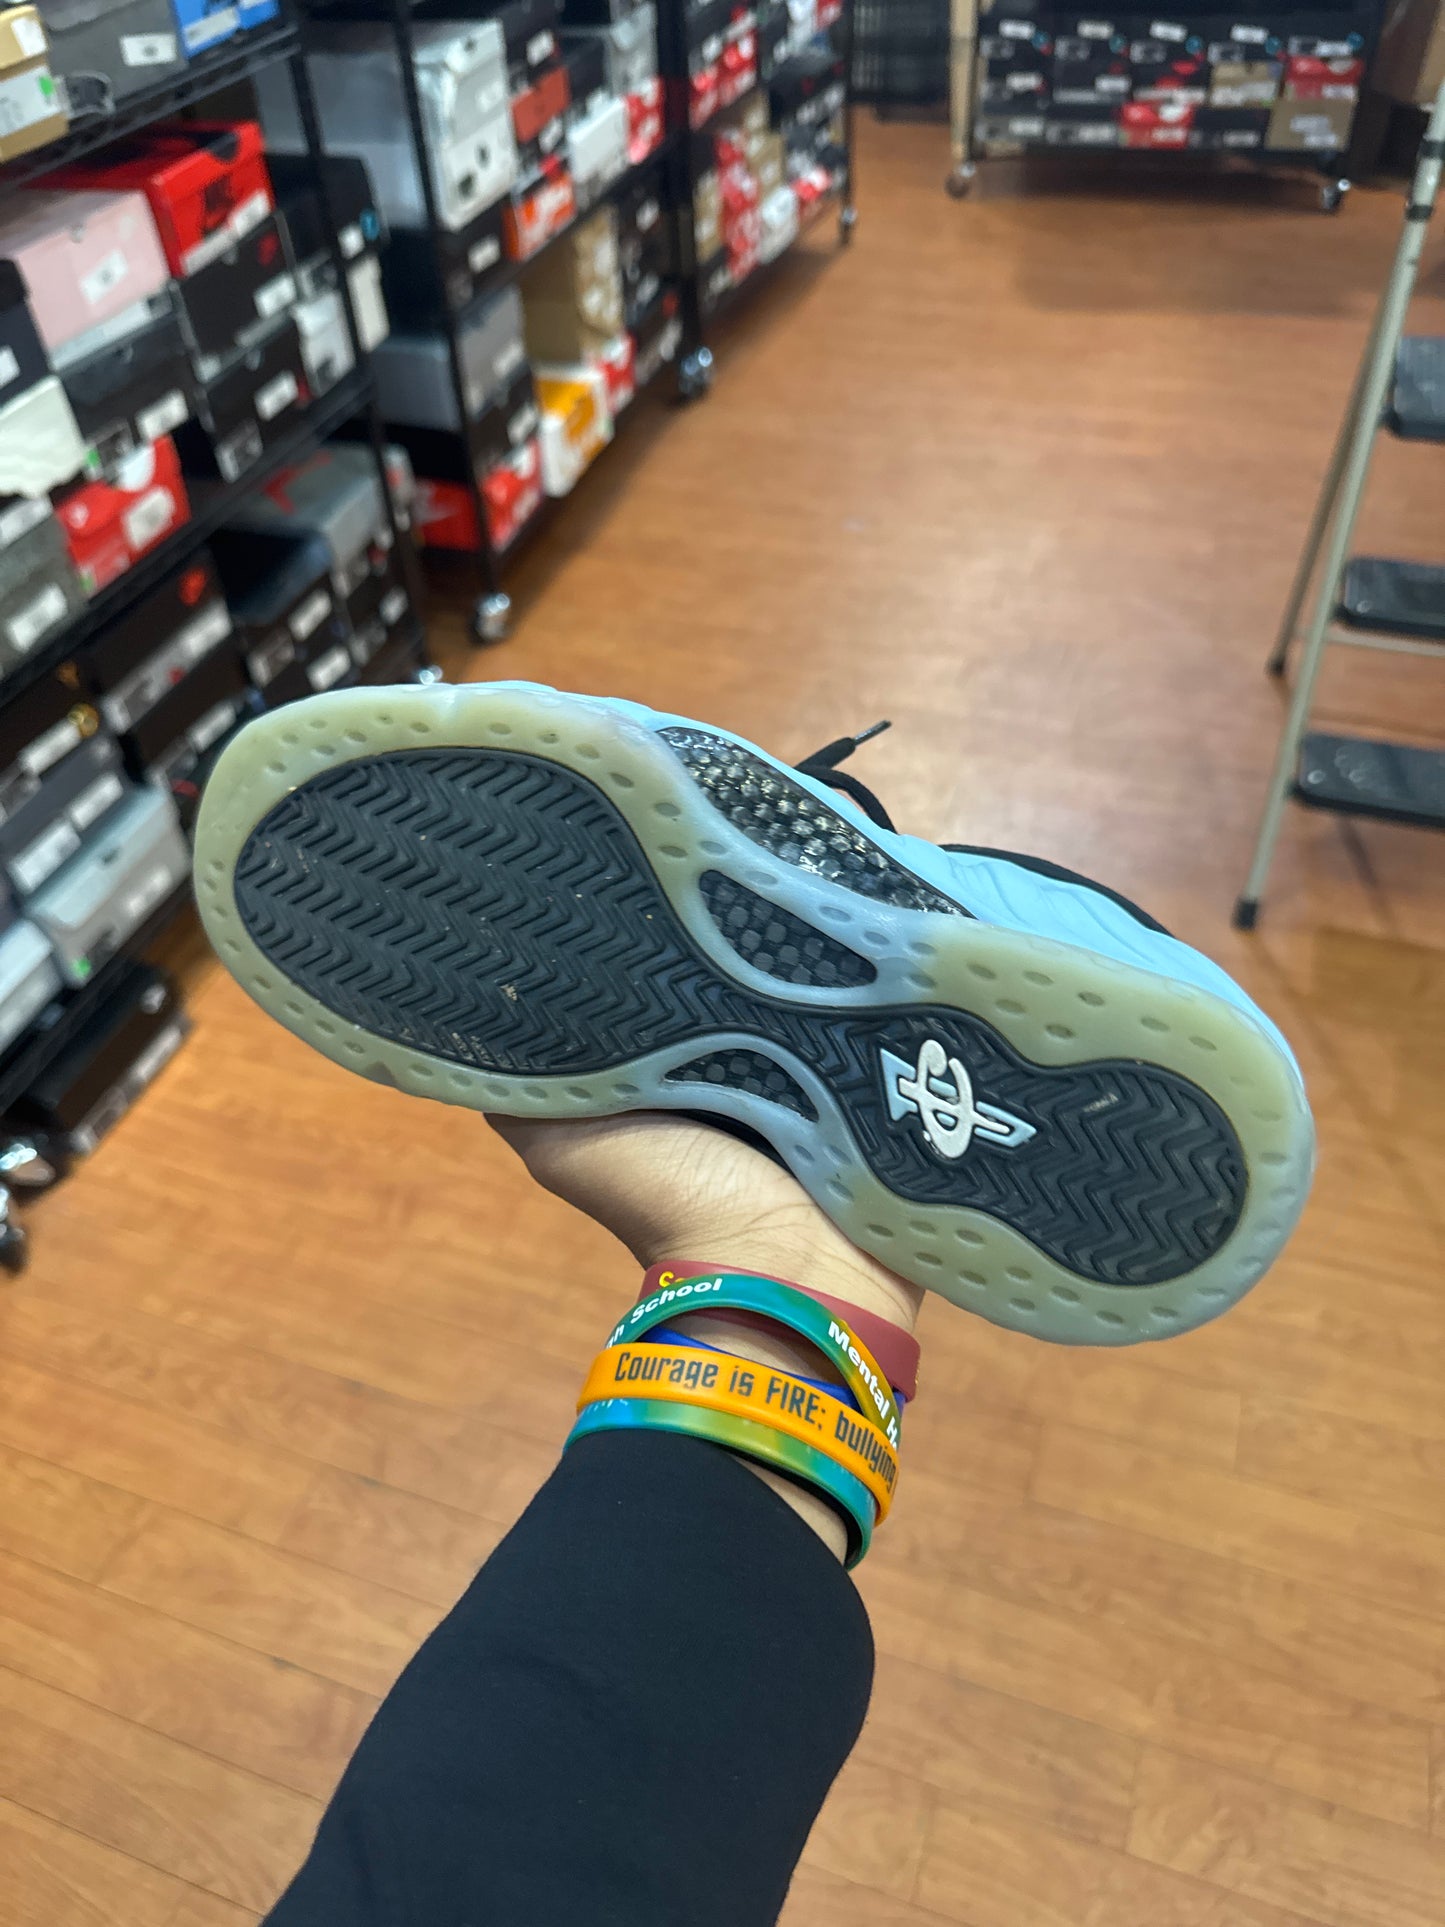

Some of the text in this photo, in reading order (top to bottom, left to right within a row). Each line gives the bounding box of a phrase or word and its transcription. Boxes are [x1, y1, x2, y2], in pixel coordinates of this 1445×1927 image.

[630, 1278, 723, 1324] School
[828, 1321, 890, 1419] Mental
[614, 1352, 719, 1390] Courage
[729, 1365, 755, 1397] is
[834, 1410, 897, 1494] bullying
